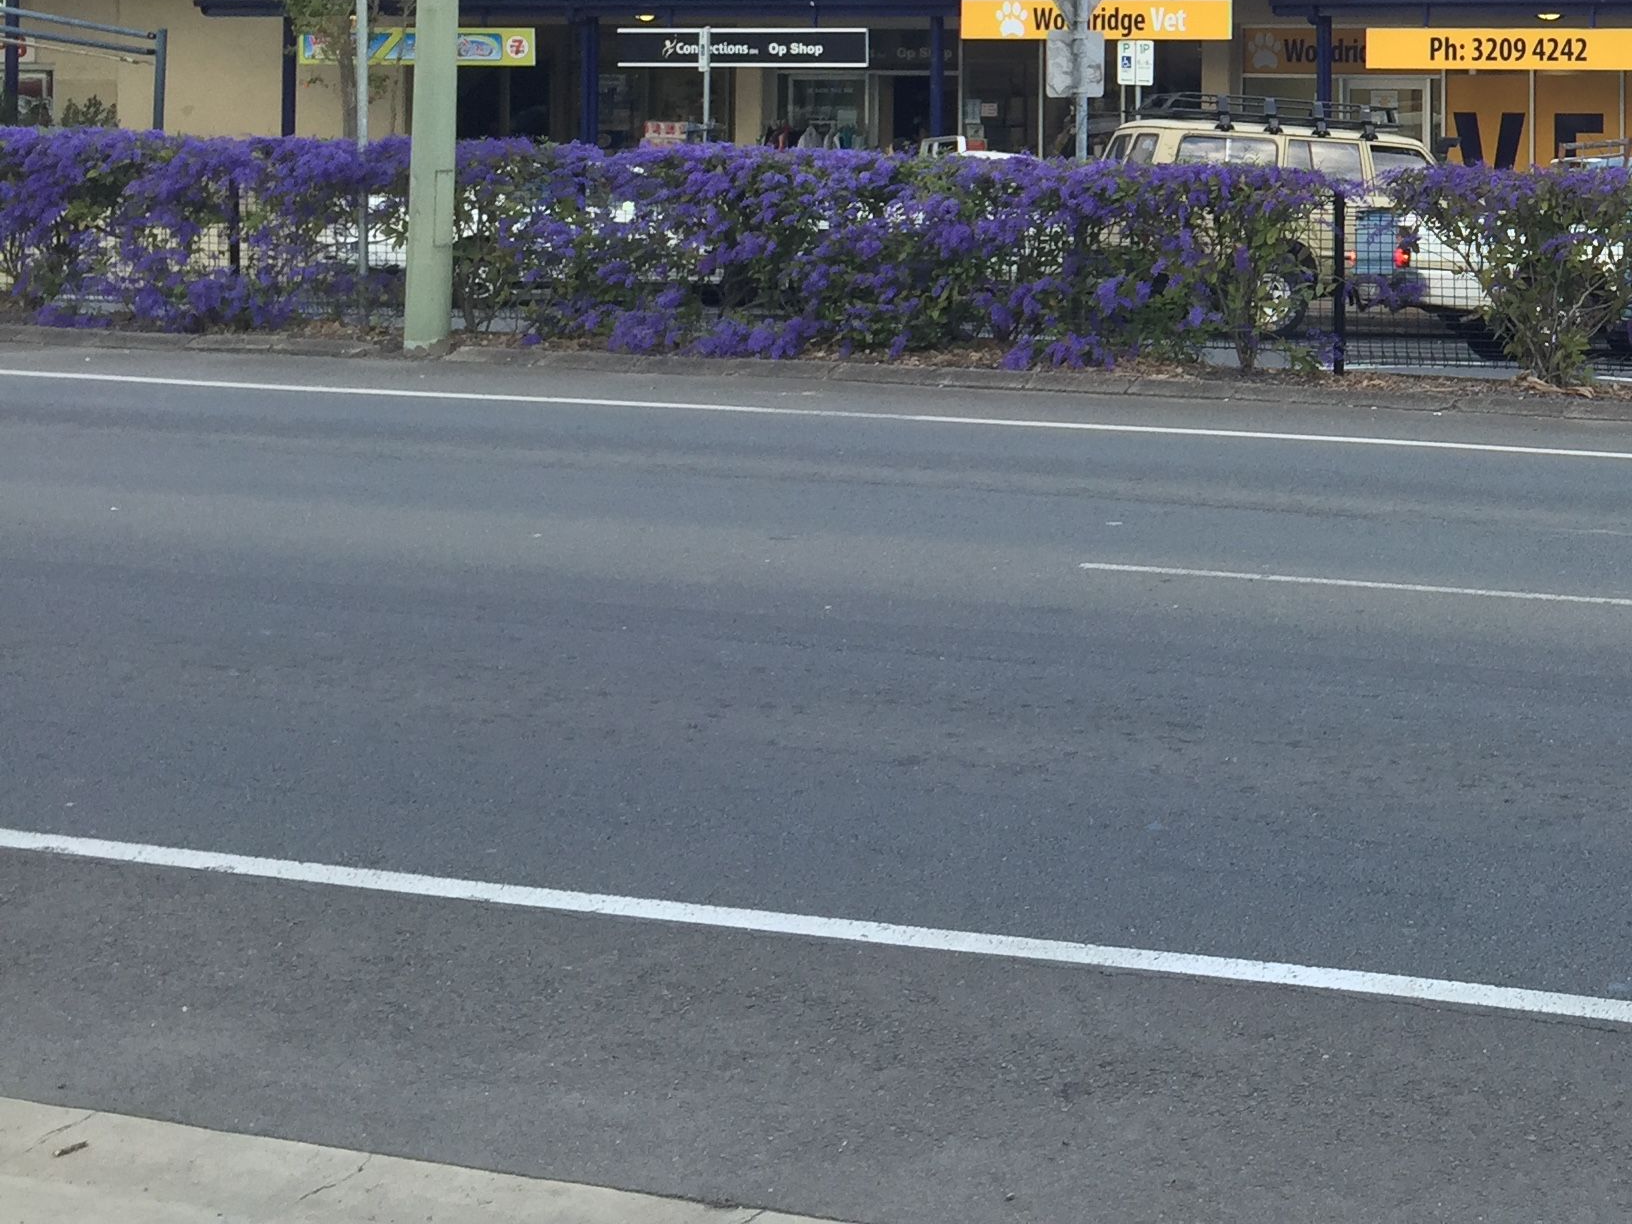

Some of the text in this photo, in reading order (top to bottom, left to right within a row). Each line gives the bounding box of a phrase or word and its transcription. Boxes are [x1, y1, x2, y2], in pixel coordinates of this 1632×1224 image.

[1033, 7, 1187, 38] Woridge Vet
[675, 39, 824, 57] Conctions Op Shop
[1122, 42, 1131, 54] P
[1430, 37, 1588, 62] Ph: 3209 4242
